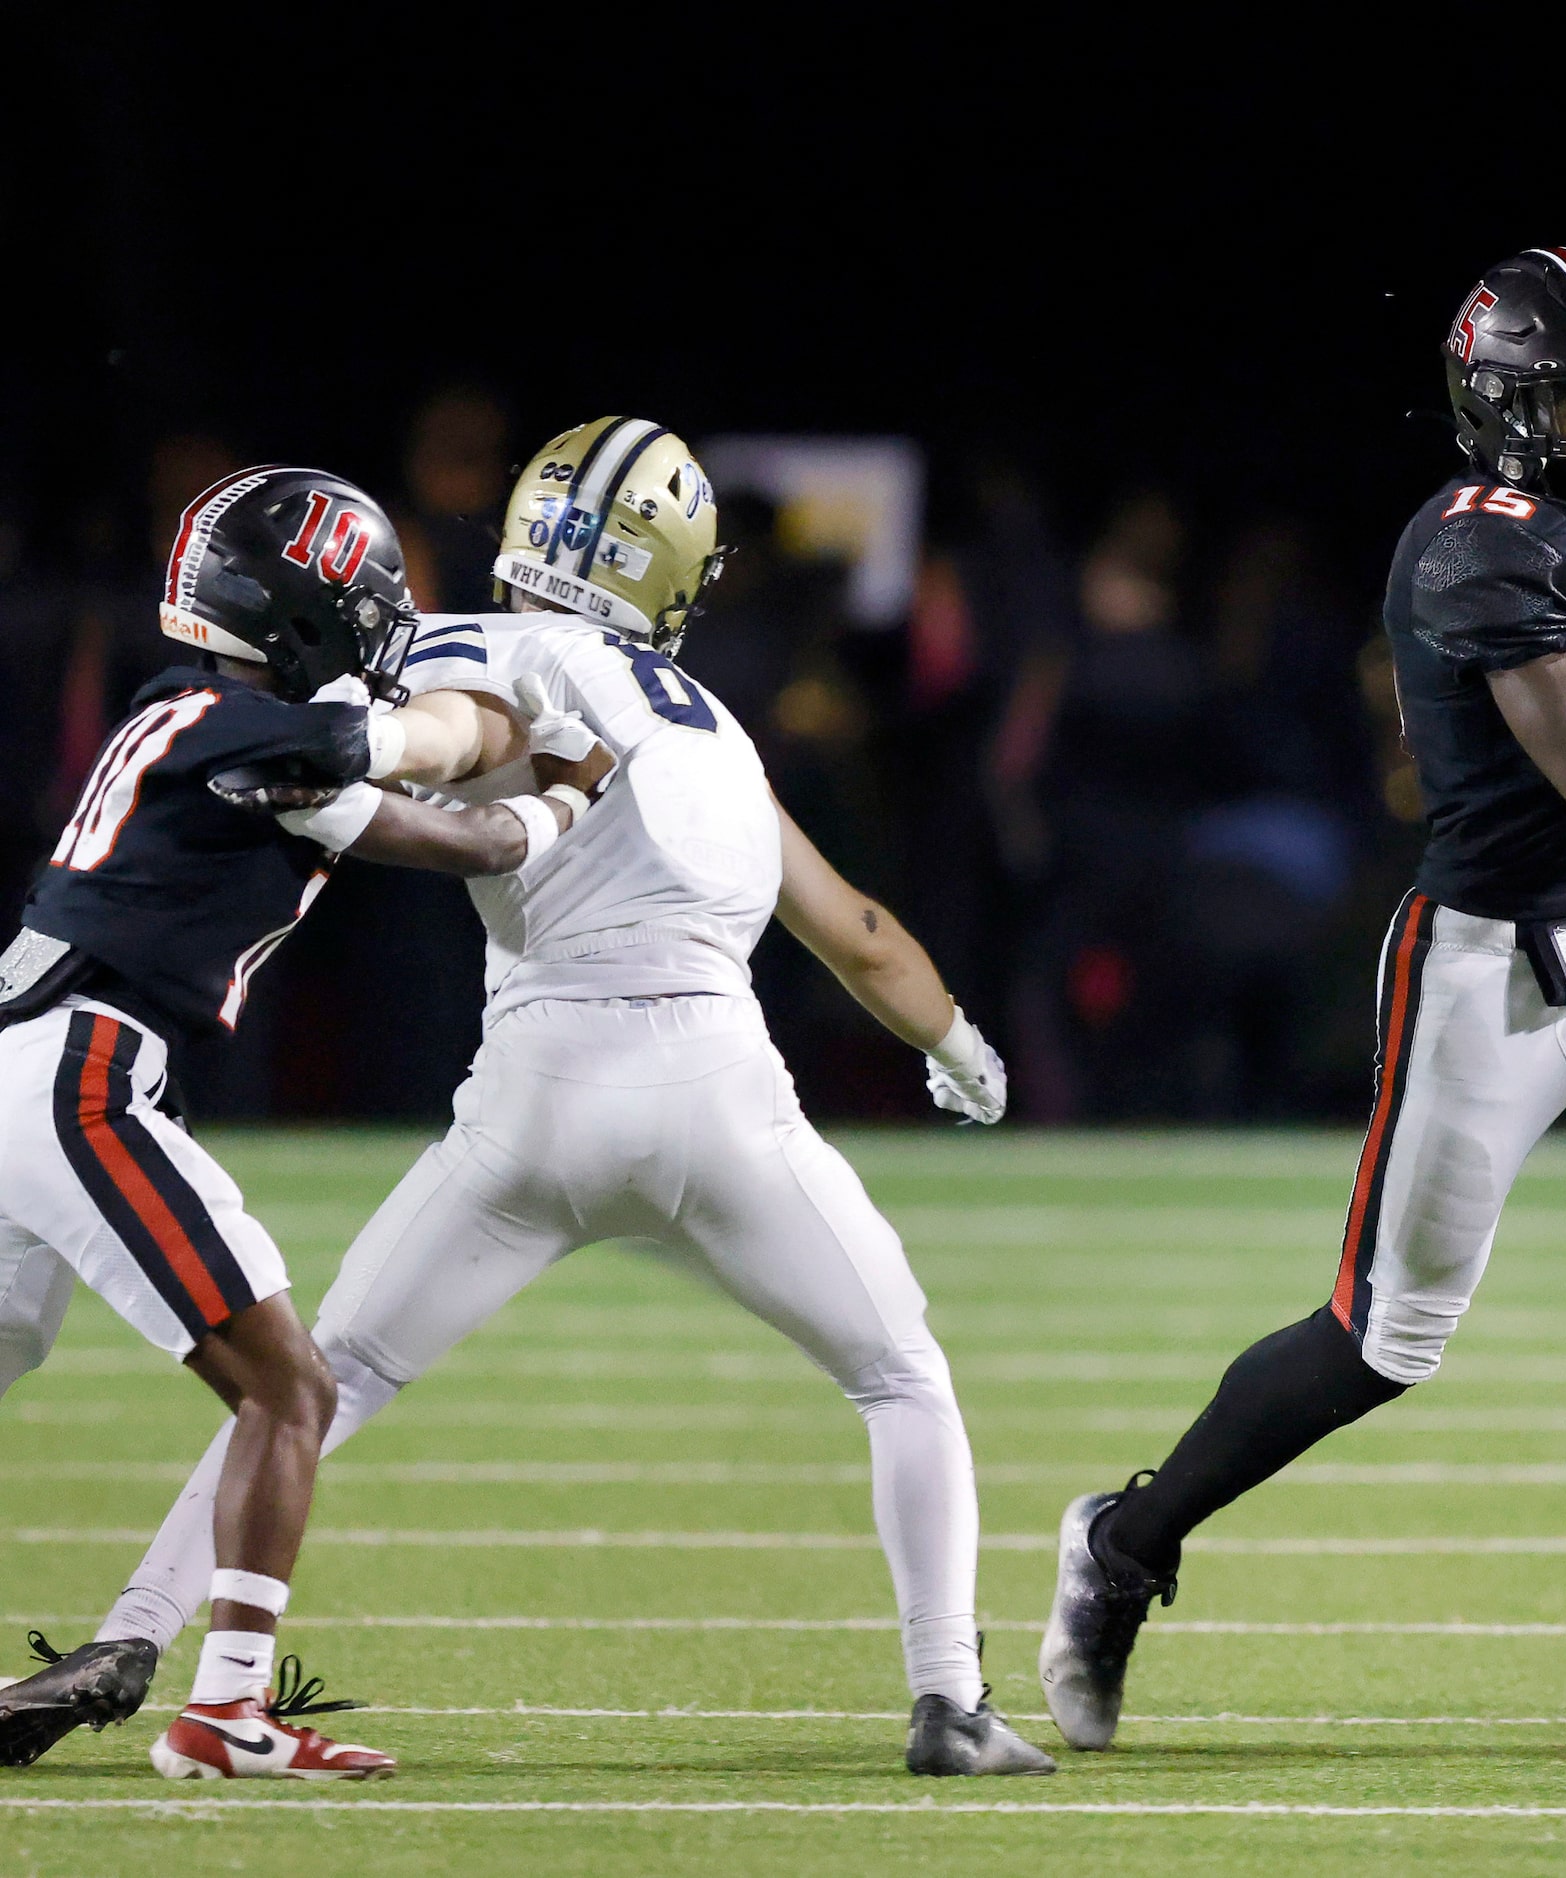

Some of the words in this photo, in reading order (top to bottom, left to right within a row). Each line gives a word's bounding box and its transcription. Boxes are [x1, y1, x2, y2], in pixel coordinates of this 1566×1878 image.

[1449, 280, 1499, 364] 5
[1441, 484, 1537, 520] 15
[280, 489, 373, 588] 10
[510, 560, 544, 588] WHY
[546, 577, 585, 604] NOT
[589, 592, 614, 618] US
